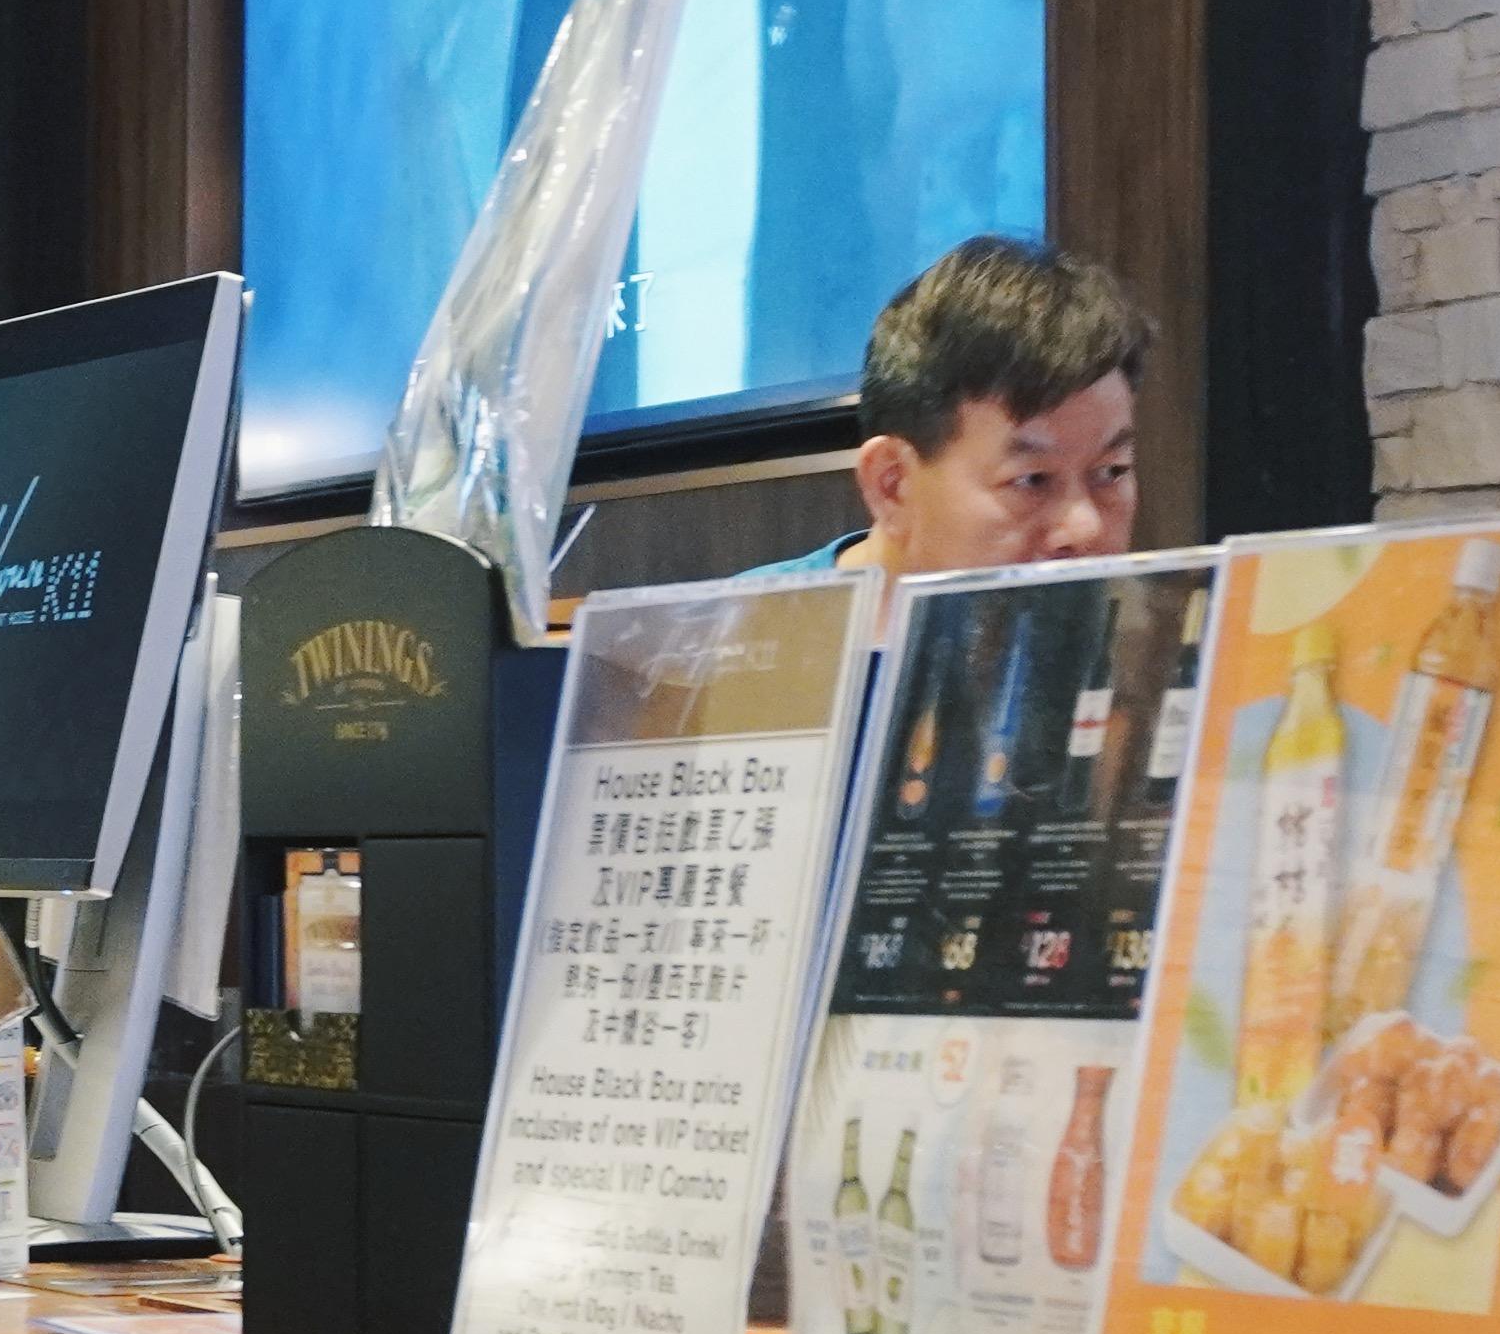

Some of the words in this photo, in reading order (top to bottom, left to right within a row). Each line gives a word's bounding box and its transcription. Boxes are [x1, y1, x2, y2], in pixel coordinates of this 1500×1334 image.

[290, 620, 448, 698] TWININGS
[593, 766, 661, 801] House
[669, 760, 733, 798] Black
[741, 756, 789, 795] Box
[530, 1066, 586, 1097] House
[591, 1067, 643, 1100] Black
[649, 1069, 687, 1102] Box
[689, 1074, 742, 1110] price
[508, 1108, 584, 1143] inclusive
[588, 1113, 611, 1144] of
[612, 1123, 647, 1148] one
[654, 1117, 690, 1150] VIP
[693, 1121, 751, 1155] ticket
[512, 1156, 548, 1186] and
[549, 1161, 615, 1197] special
[621, 1161, 654, 1194] VIP
[658, 1162, 728, 1202] Combo
[585, 1297, 618, 1331] Dog
[633, 1303, 685, 1334] Nacho
